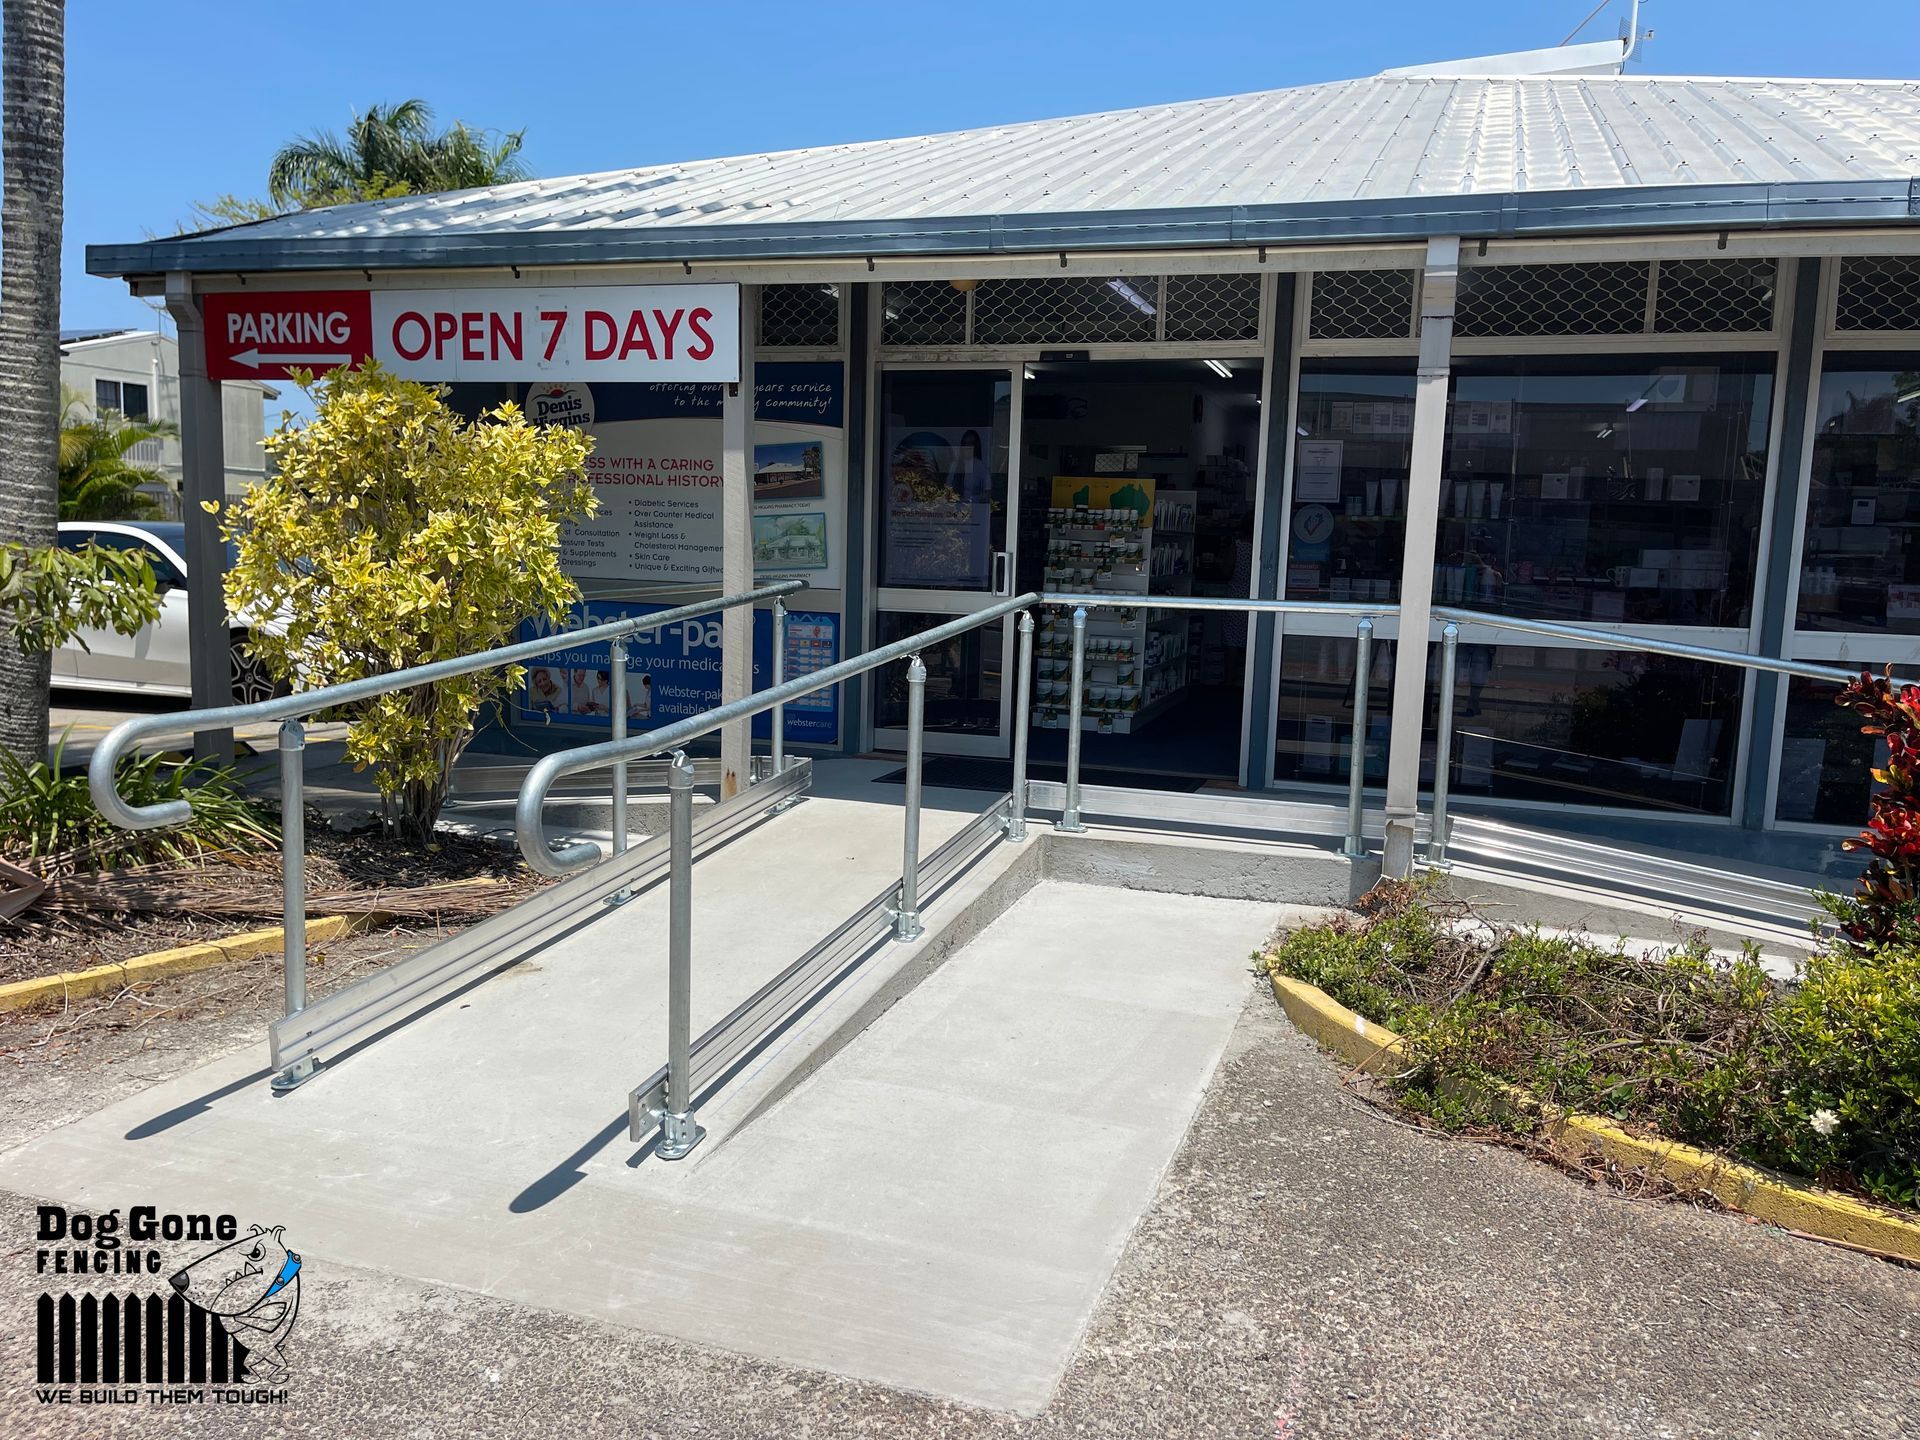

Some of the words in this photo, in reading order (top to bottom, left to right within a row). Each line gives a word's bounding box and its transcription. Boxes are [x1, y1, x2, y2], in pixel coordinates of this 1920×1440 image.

[227, 310, 350, 345] PARKING
[392, 311, 523, 361] OPEN
[540, 310, 568, 361] 7
[584, 306, 715, 361] DAYS
[649, 382, 697, 395] offering
[701, 383, 724, 393] over
[753, 383, 784, 397] years
[790, 383, 832, 393] service
[537, 395, 582, 416] Denis
[674, 396, 687, 406] to
[691, 395, 710, 407] the
[766, 396, 832, 414] community!
[610, 457, 643, 470] WITH
[647, 458, 657, 470] A
[660, 458, 714, 471] CARING
[568, 470, 664, 487] RFESSIONAL
[634, 499, 666, 508] Diabetic
[667, 500, 699, 508] Services
[634, 510, 652, 518] Over
[653, 510, 683, 518] Counter
[684, 511, 714, 520] Medical
[634, 520, 674, 529] Assistance
[575, 528, 620, 537] Consultation
[634, 531, 659, 540] Weight
[661, 532, 679, 540] Loss
[560, 539, 586, 547] ressure
[587, 539, 605, 548] Tests
[634, 541, 677, 551] Cholesterol
[678, 544, 724, 553] Managemen
[570, 549, 617, 558] Supplements
[635, 552, 652, 561] Skin
[653, 553, 670, 562] Care
[562, 558, 597, 568] Dressings
[635, 563, 662, 572] Unique
[670, 564, 700, 574] Exciting
[532, 606, 723, 656] Weber-pa
[529, 650, 562, 663] elps
[565, 653, 588, 665] you
[591, 654, 643, 670] mage
[645, 657, 677, 671] your
[658, 702, 705, 715] available
[787, 717, 833, 729] webstercare
